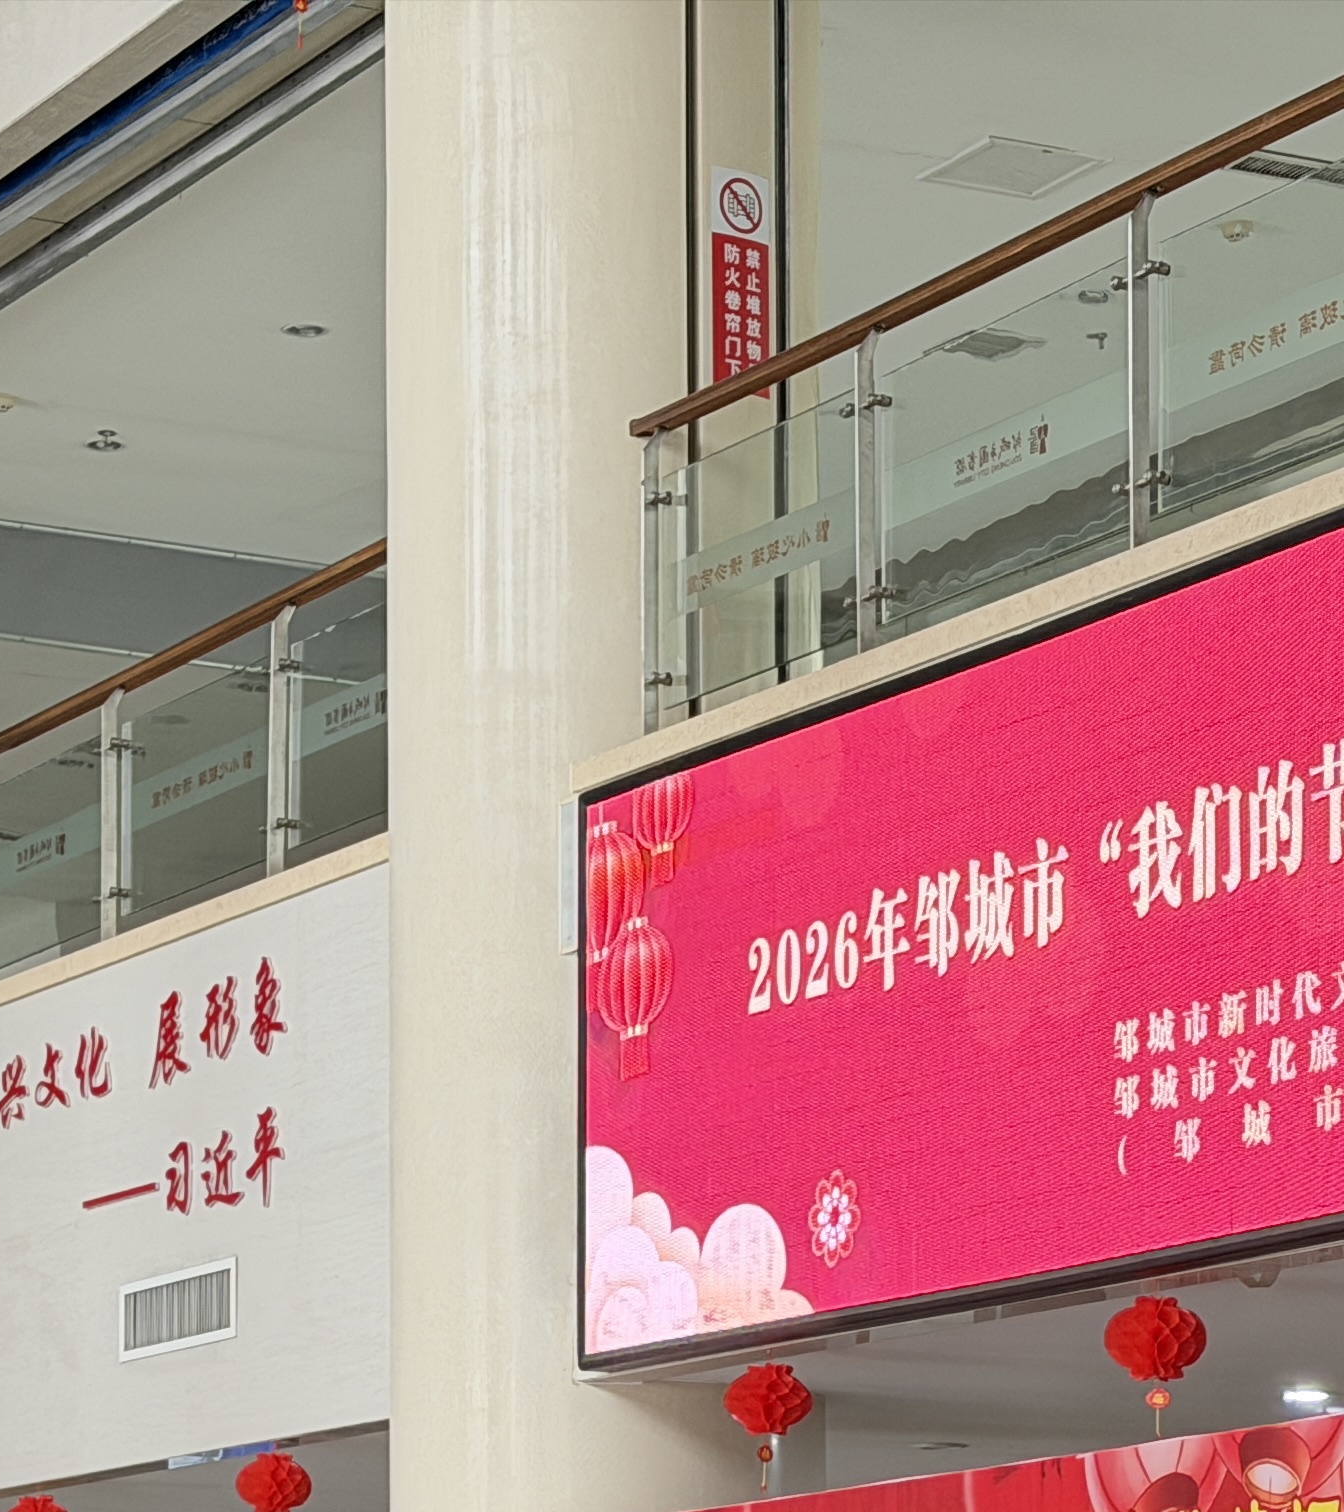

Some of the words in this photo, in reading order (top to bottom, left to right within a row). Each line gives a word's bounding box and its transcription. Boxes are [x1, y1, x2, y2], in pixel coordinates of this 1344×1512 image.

[745, 248, 762, 374] 禁止堆放物
[147, 955, 290, 1092] 展形象
